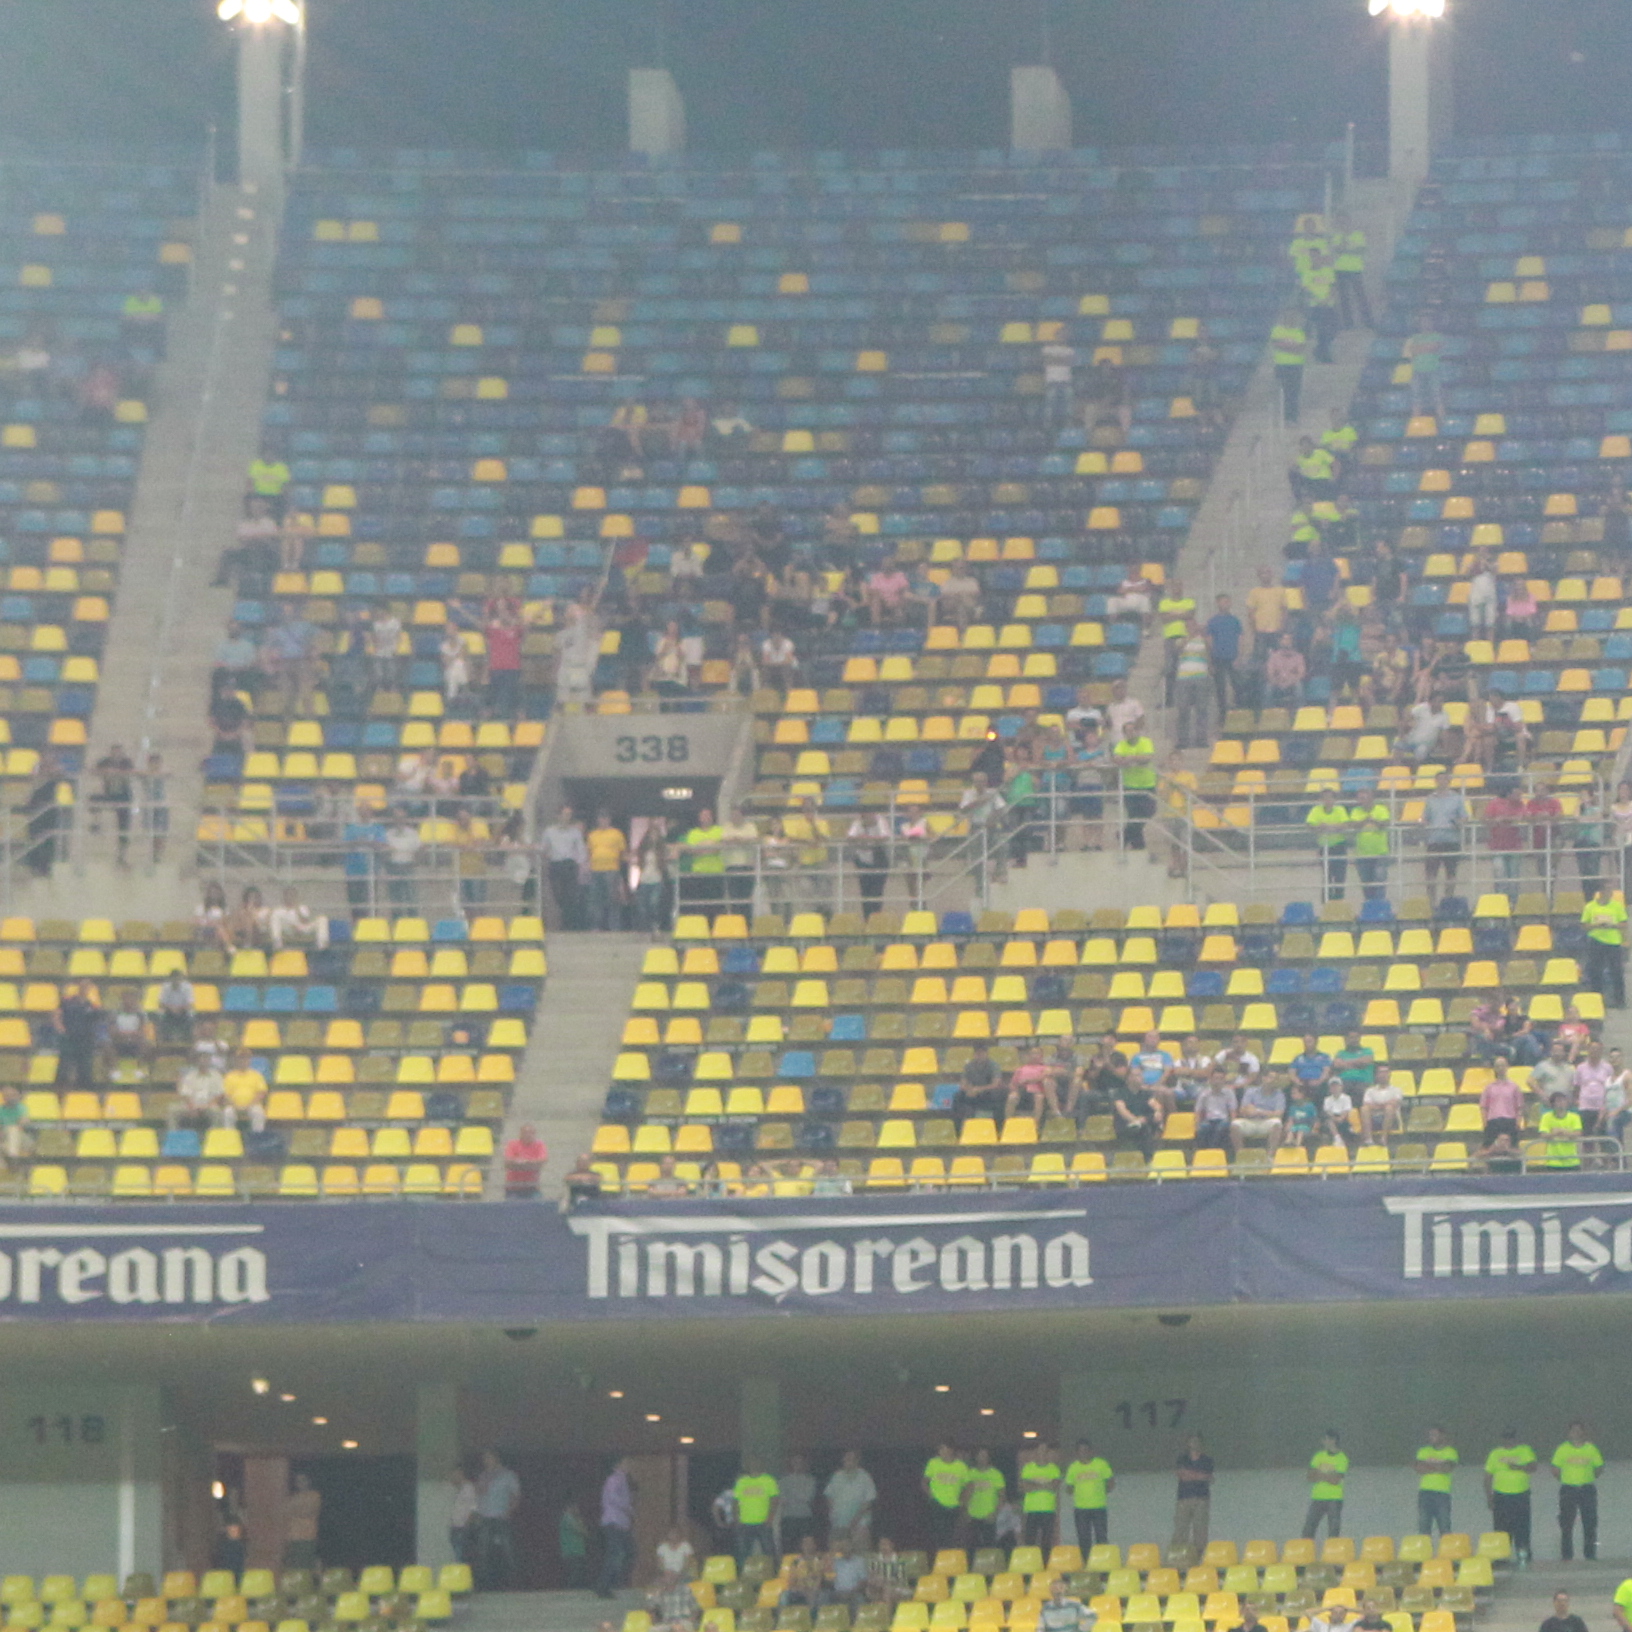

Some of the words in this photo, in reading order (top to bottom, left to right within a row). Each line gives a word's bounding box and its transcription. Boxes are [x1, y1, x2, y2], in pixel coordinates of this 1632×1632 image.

[615, 734, 691, 763] 338
[0, 1224, 270, 1304] reana
[1116, 1399, 1189, 1429] 117
[28, 1415, 105, 1444] 118
